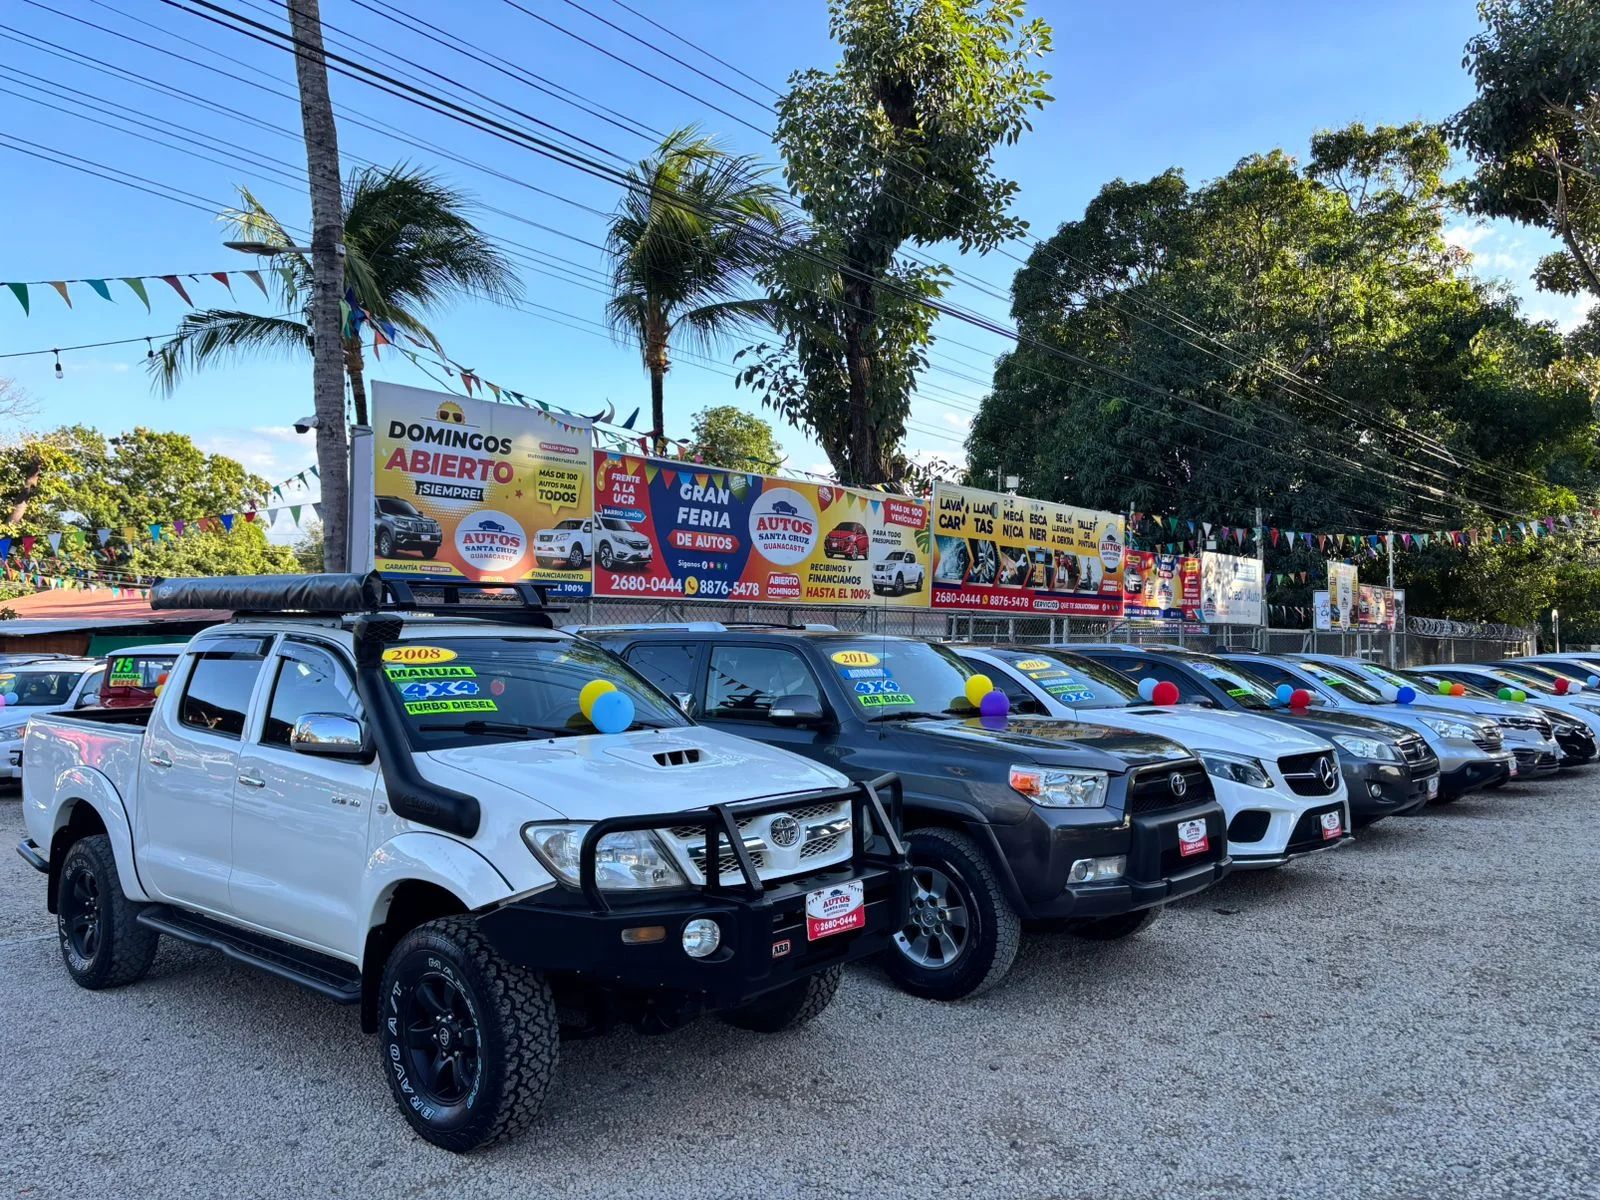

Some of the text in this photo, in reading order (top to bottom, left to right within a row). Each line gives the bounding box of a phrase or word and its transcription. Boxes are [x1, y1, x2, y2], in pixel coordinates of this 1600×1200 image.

[389, 421, 512, 455] DOMINGOS
[384, 448, 514, 484] ABIERTO
[539, 469, 554, 478] MÁS
[612, 473, 640, 483] FRENTE
[419, 482, 480, 500] ¡SIEMPRE!
[539, 489, 576, 502] TODOS
[623, 485, 635, 494] LA
[680, 484, 729, 504] GRAN
[613, 494, 635, 504] UCR
[625, 509, 642, 518] LIMÓN
[677, 507, 731, 529] FERIA
[911, 507, 923, 517] 100
[940, 498, 962, 512] LAVA
[1003, 509, 1024, 523] MECÁ
[1030, 513, 1047, 526] ESCA
[1056, 513, 1063, 522] SE
[756, 517, 812, 535] AUTOS
[939, 514, 960, 530] CAR
[974, 518, 993, 534] TAS
[1030, 527, 1047, 542] NER
[1052, 525, 1074, 534] LLEVAMOS
[462, 533, 520, 548] AUTOS
[677, 533, 732, 550] DE AUTOS
[790, 535, 809, 544] CRUZ
[1052, 535, 1096, 549] A DEKRA PINTURA
[496, 546, 518, 555] CRUZ
[764, 543, 804, 552] GUANACASTE
[1101, 542, 1121, 552] AUTOS
[470, 553, 513, 562] GUANACASTE
[385, 562, 418, 571] GARANTÍA
[678, 560, 700, 568] Síganos
[810, 564, 846, 572] RECIBIMOS
[531, 571, 584, 580] FINANCIAMIENTO
[770, 577, 798, 585] ABIERTO
[808, 574, 861, 585] FINANCIAMOS
[611, 575, 759, 596] 2680-0444 8876-5478
[806, 587, 871, 599] HASTA EL 100%
[935, 592, 981, 604] 2680-0444
[990, 596, 1029, 607] 8876-5478
[1034, 601, 1058, 609] SERVICIOS
[392, 649, 440, 660] 2008
[842, 653, 869, 663] 2011
[390, 668, 472, 678] MANUAL
[403, 681, 478, 697] 4X4
[856, 681, 899, 694] 4X4
[864, 694, 910, 704] AIR BAGS
[407, 700, 493, 712] TURBO DIESEL
[823, 895, 850, 908] AUTOS
[820, 914, 857, 931] 2680-0444
[773, 943, 789, 955] ARB
[388, 981, 402, 1036] A/T
[390, 1044, 435, 1120] BRAVO
